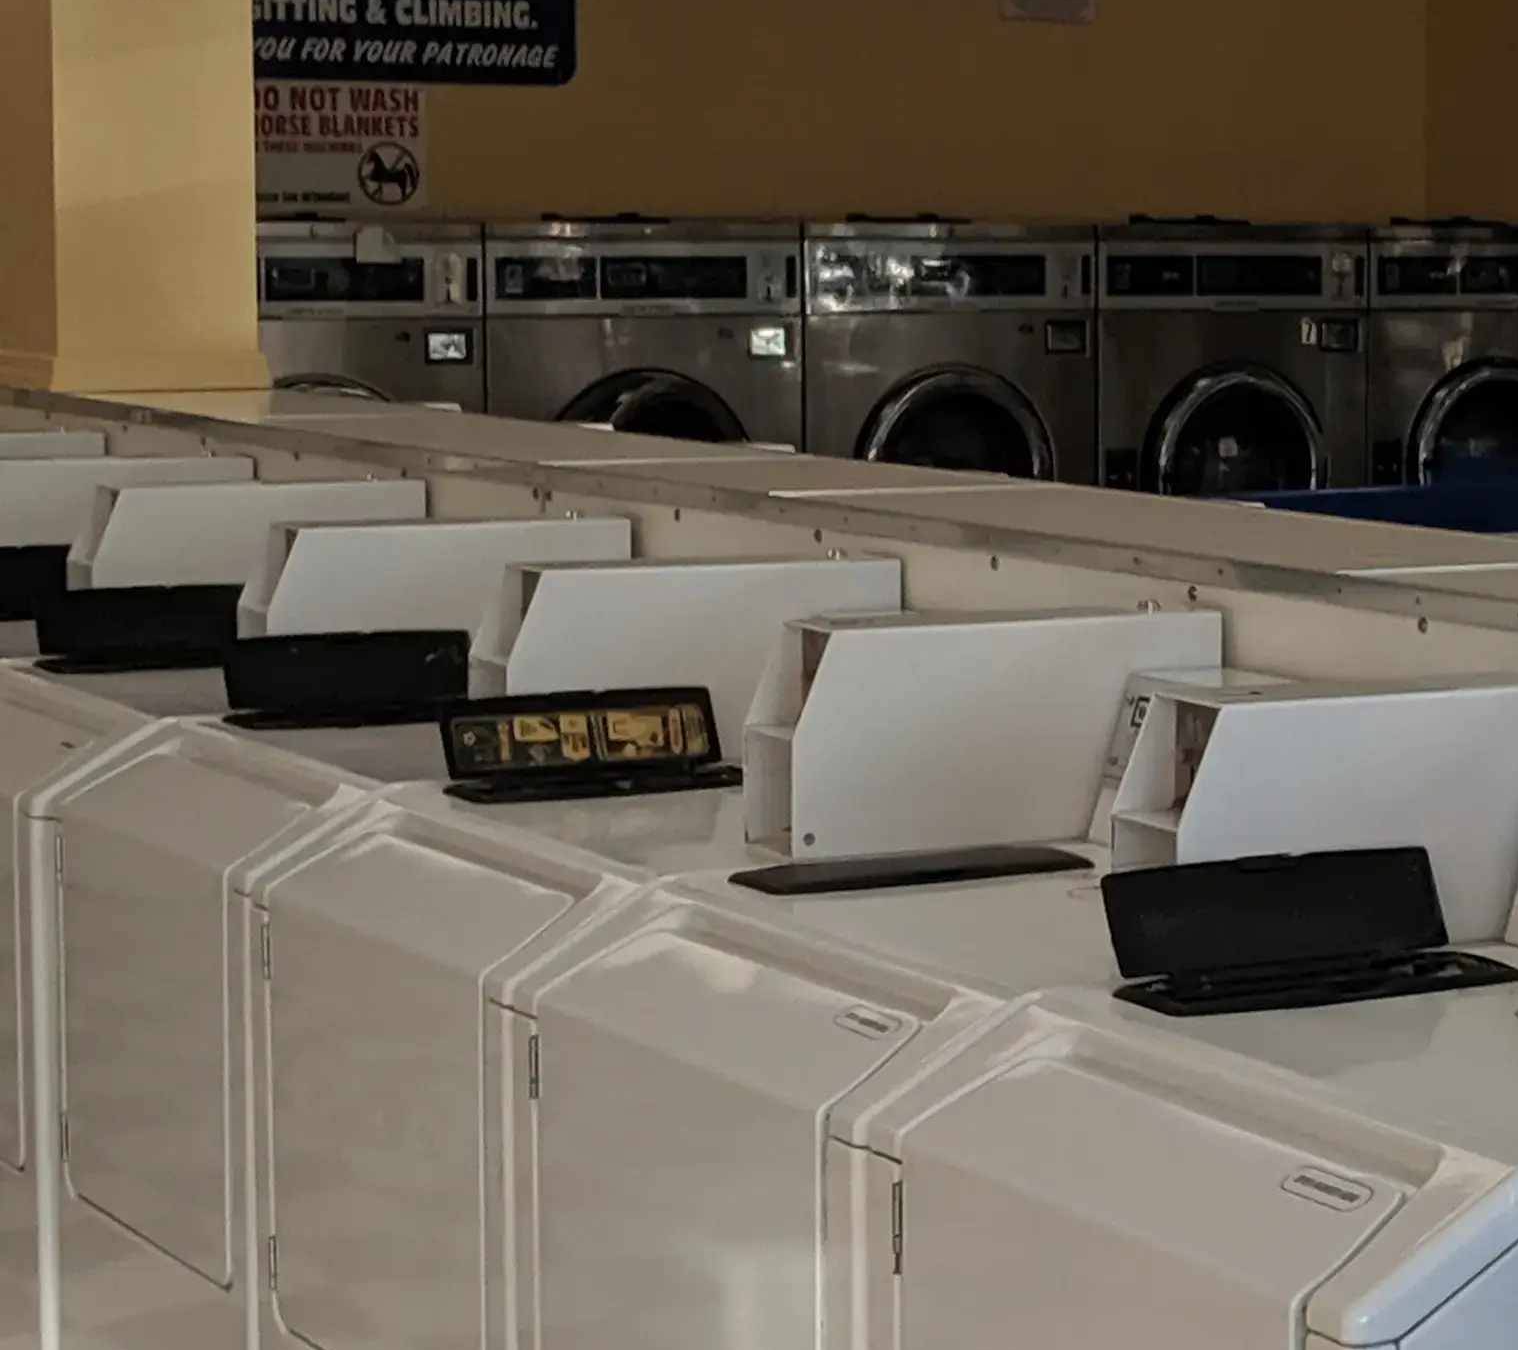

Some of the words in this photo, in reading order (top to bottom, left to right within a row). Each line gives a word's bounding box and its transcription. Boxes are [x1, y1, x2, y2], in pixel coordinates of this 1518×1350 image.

[300, 37, 347, 63] FOR
[352, 39, 418, 66] YOUR
[421, 41, 561, 70] PATRONAGE
[290, 86, 342, 112] NOT
[350, 87, 419, 112] WASH
[319, 115, 420, 138] BLANKETS
